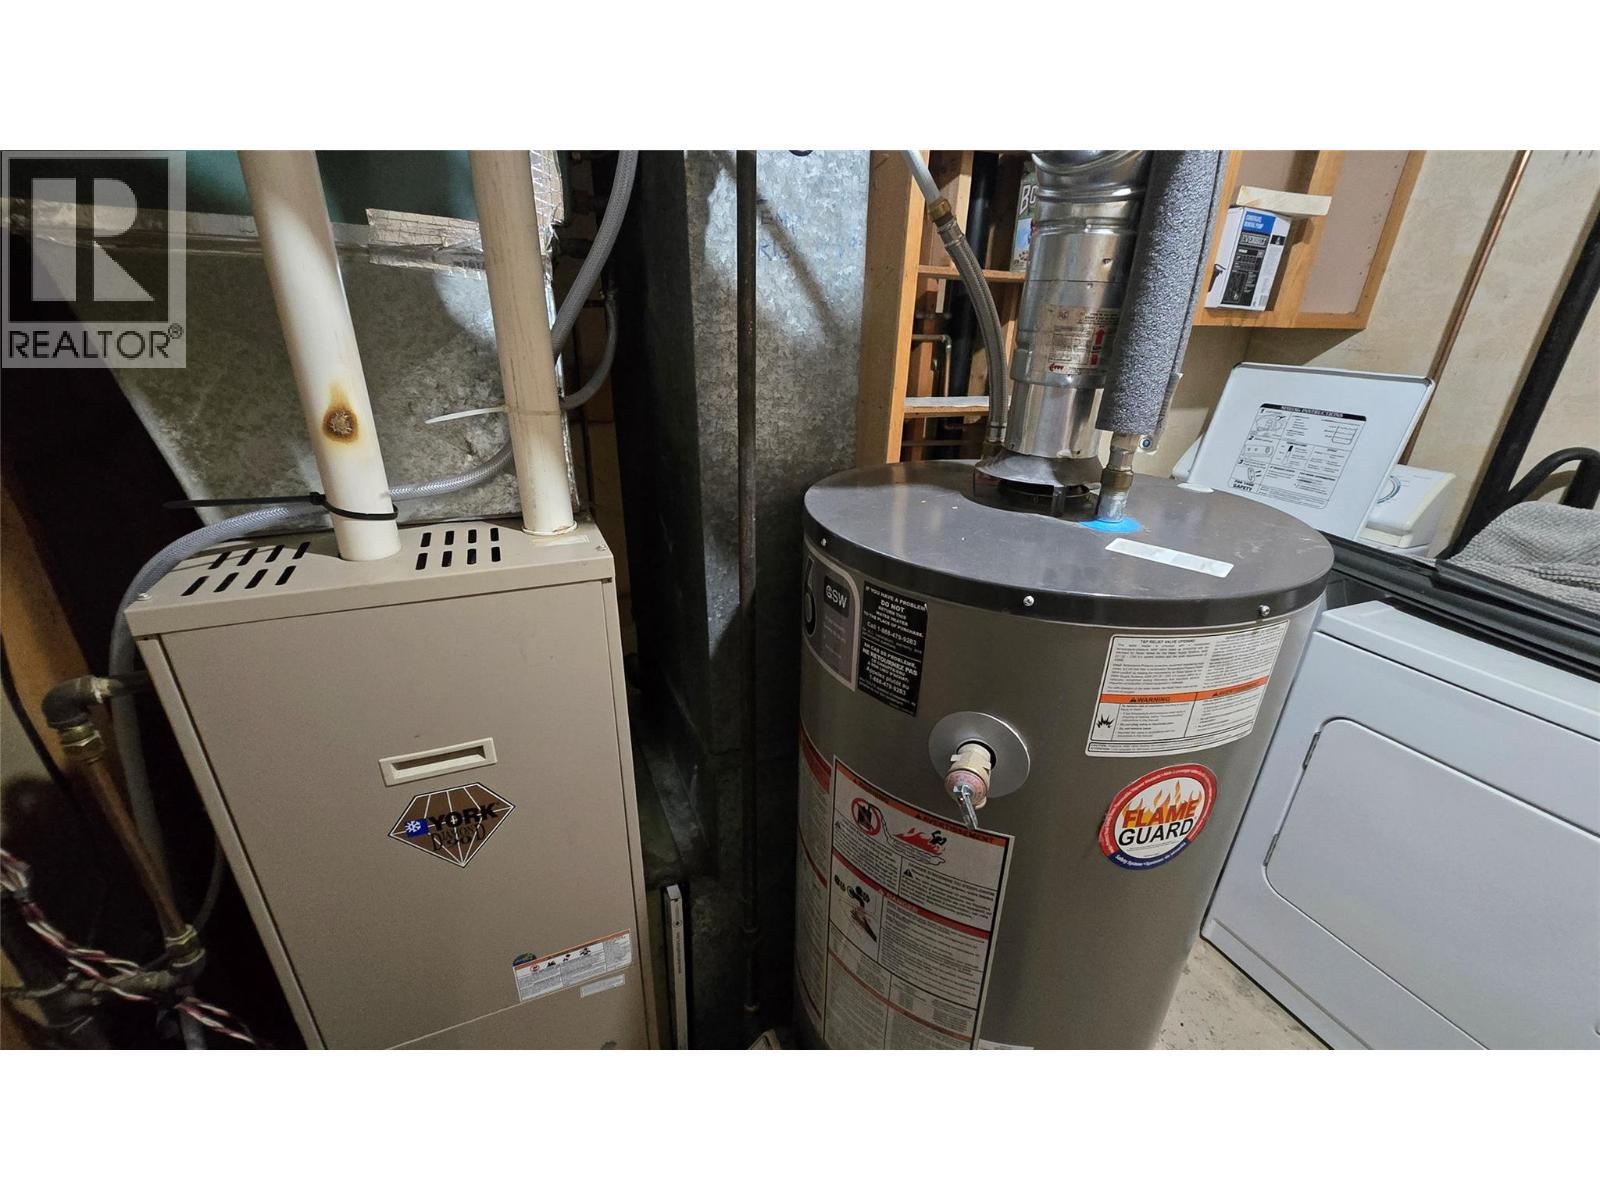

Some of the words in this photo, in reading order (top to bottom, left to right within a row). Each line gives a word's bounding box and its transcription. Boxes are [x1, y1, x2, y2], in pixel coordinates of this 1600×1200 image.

[1233, 484, 1252, 492] SAFETY
[825, 584, 847, 609] GSW
[881, 592, 894, 601] HAVE
[899, 600, 927, 611] PROBLEM
[878, 605, 895, 616] RETURN
[881, 599, 890, 608] DO
[891, 603, 905, 613] NOT
[876, 610, 890, 620] WATER
[890, 616, 908, 627] HEATER
[877, 617, 890, 626] PLACE
[871, 645, 879, 653] CAS
[863, 648, 870, 656] NE
[870, 652, 904, 670] RETOURNEZ
[905, 666, 918, 676] PAS
[429, 802, 498, 831] YORK
[1122, 799, 1199, 828] FLAME
[1119, 818, 1194, 846] GUARD
[1115, 854, 1129, 864] Safety
